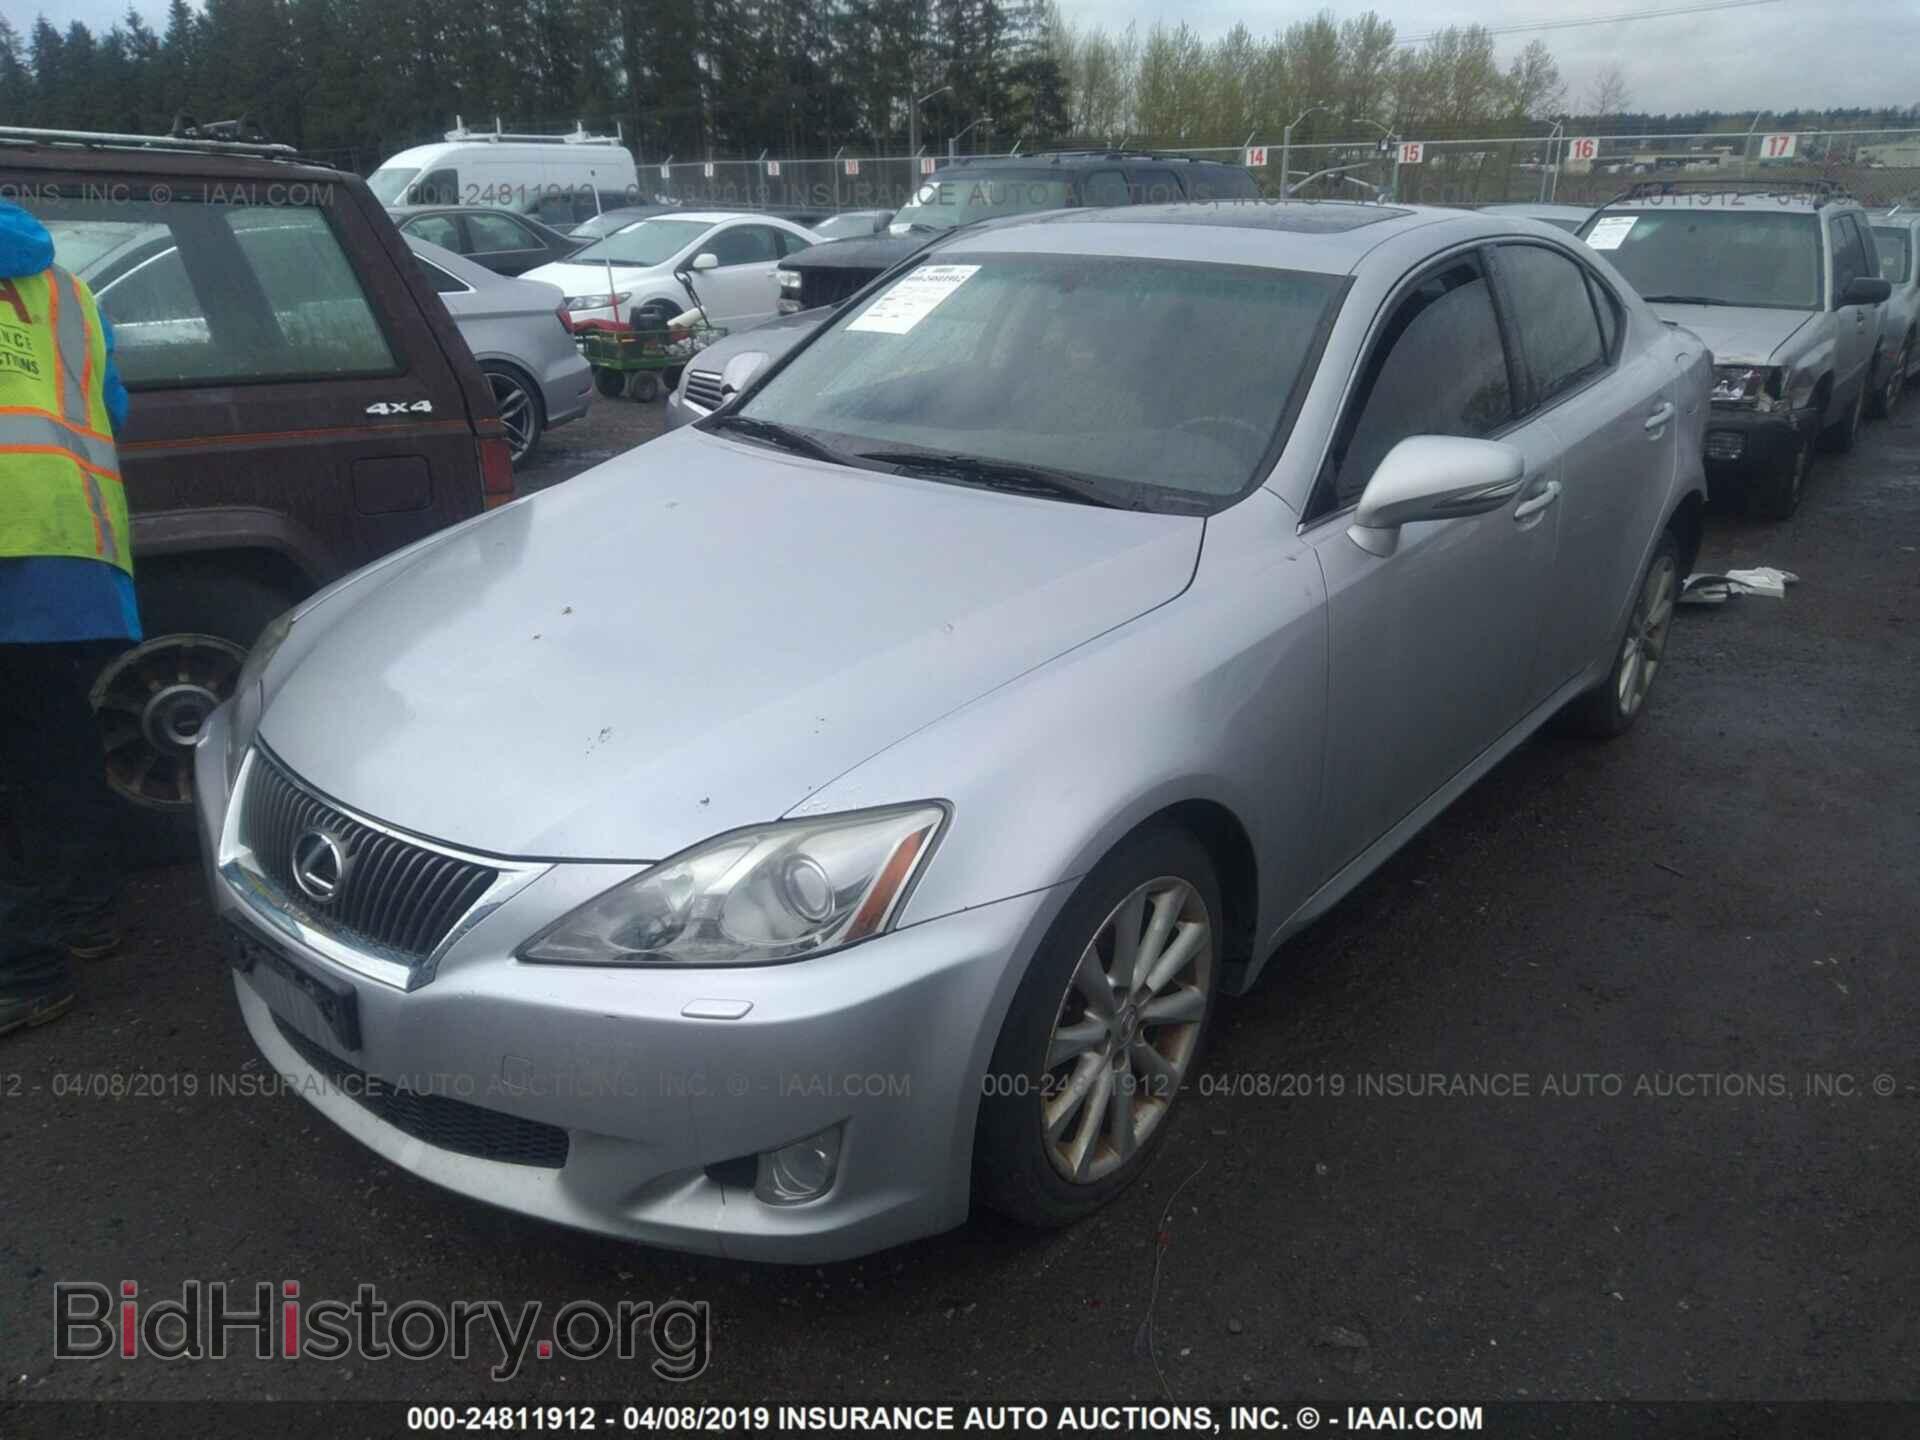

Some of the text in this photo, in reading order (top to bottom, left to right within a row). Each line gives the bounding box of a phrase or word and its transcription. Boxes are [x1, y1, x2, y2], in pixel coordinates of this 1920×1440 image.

[1249, 147, 1265, 165] 14
[1403, 144, 1420, 162] 15
[1574, 139, 1594, 159] 16
[1768, 136, 1790, 157] 17
